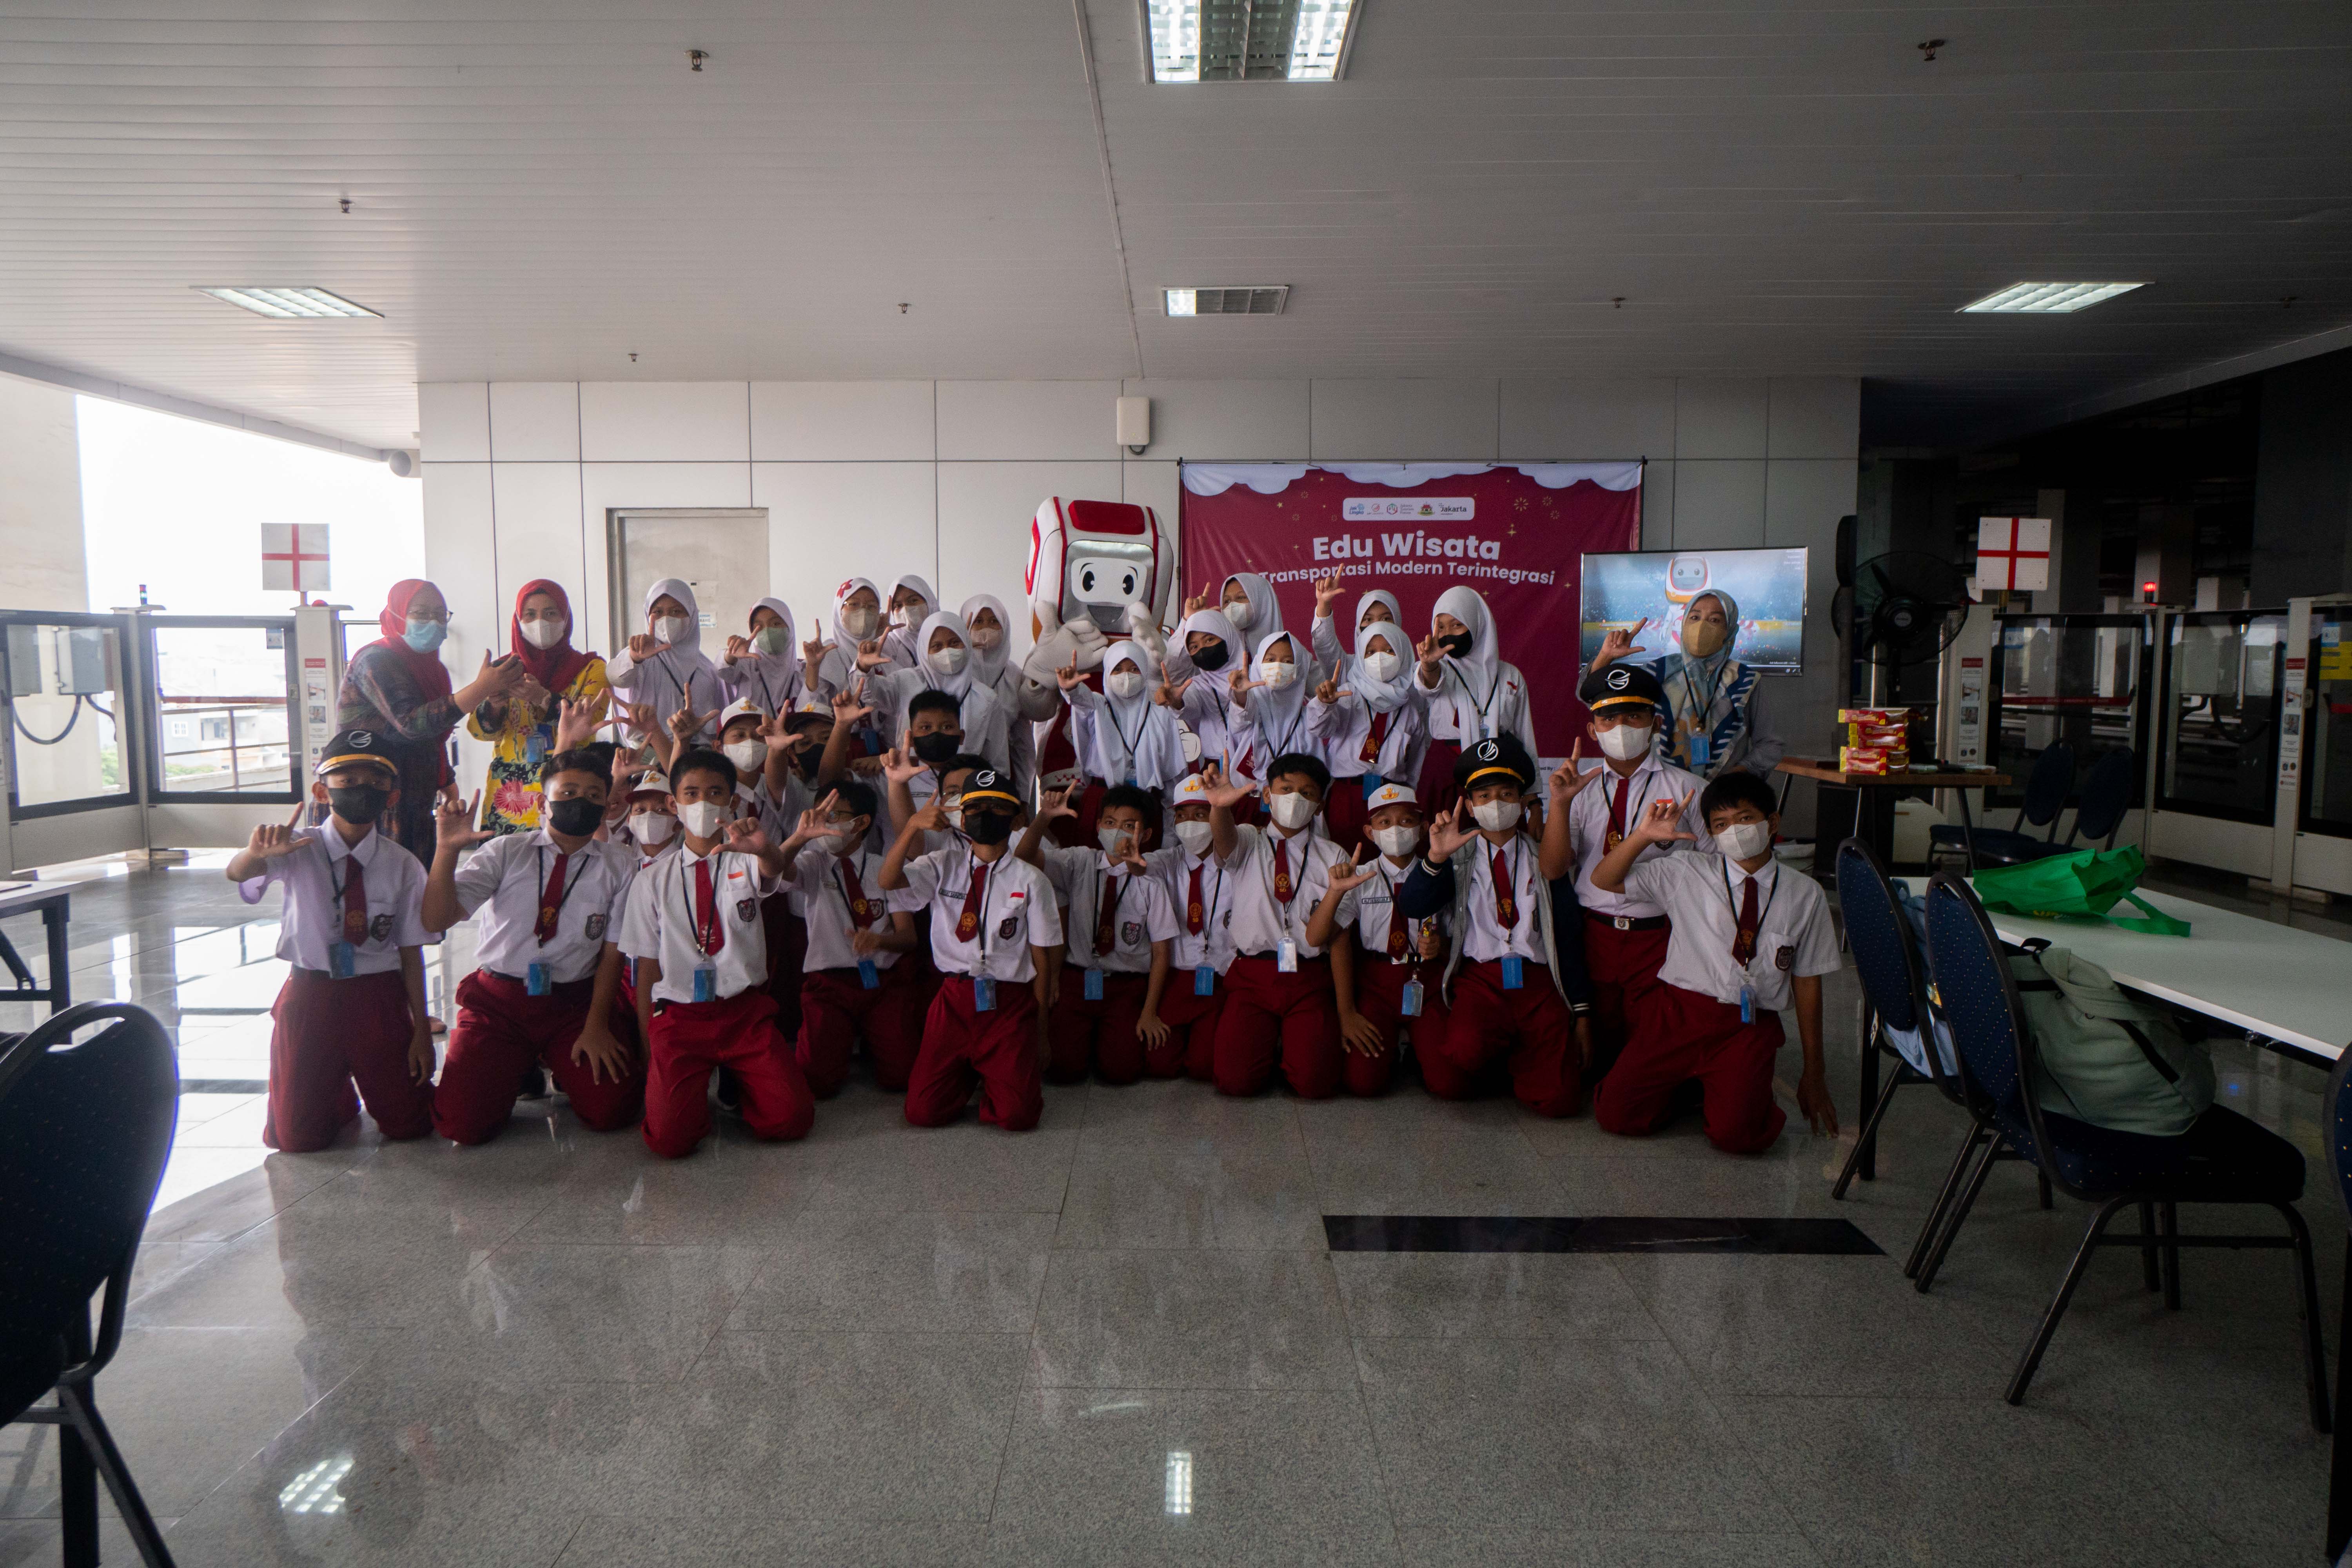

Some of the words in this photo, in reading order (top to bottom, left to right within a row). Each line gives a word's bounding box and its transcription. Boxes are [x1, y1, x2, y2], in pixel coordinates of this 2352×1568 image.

[1313, 534, 1373, 561] Edu
[1381, 530, 1501, 560] Wisata
[1376, 561, 1443, 575] Modern
[1447, 562, 1555, 585] Terintegrasi
